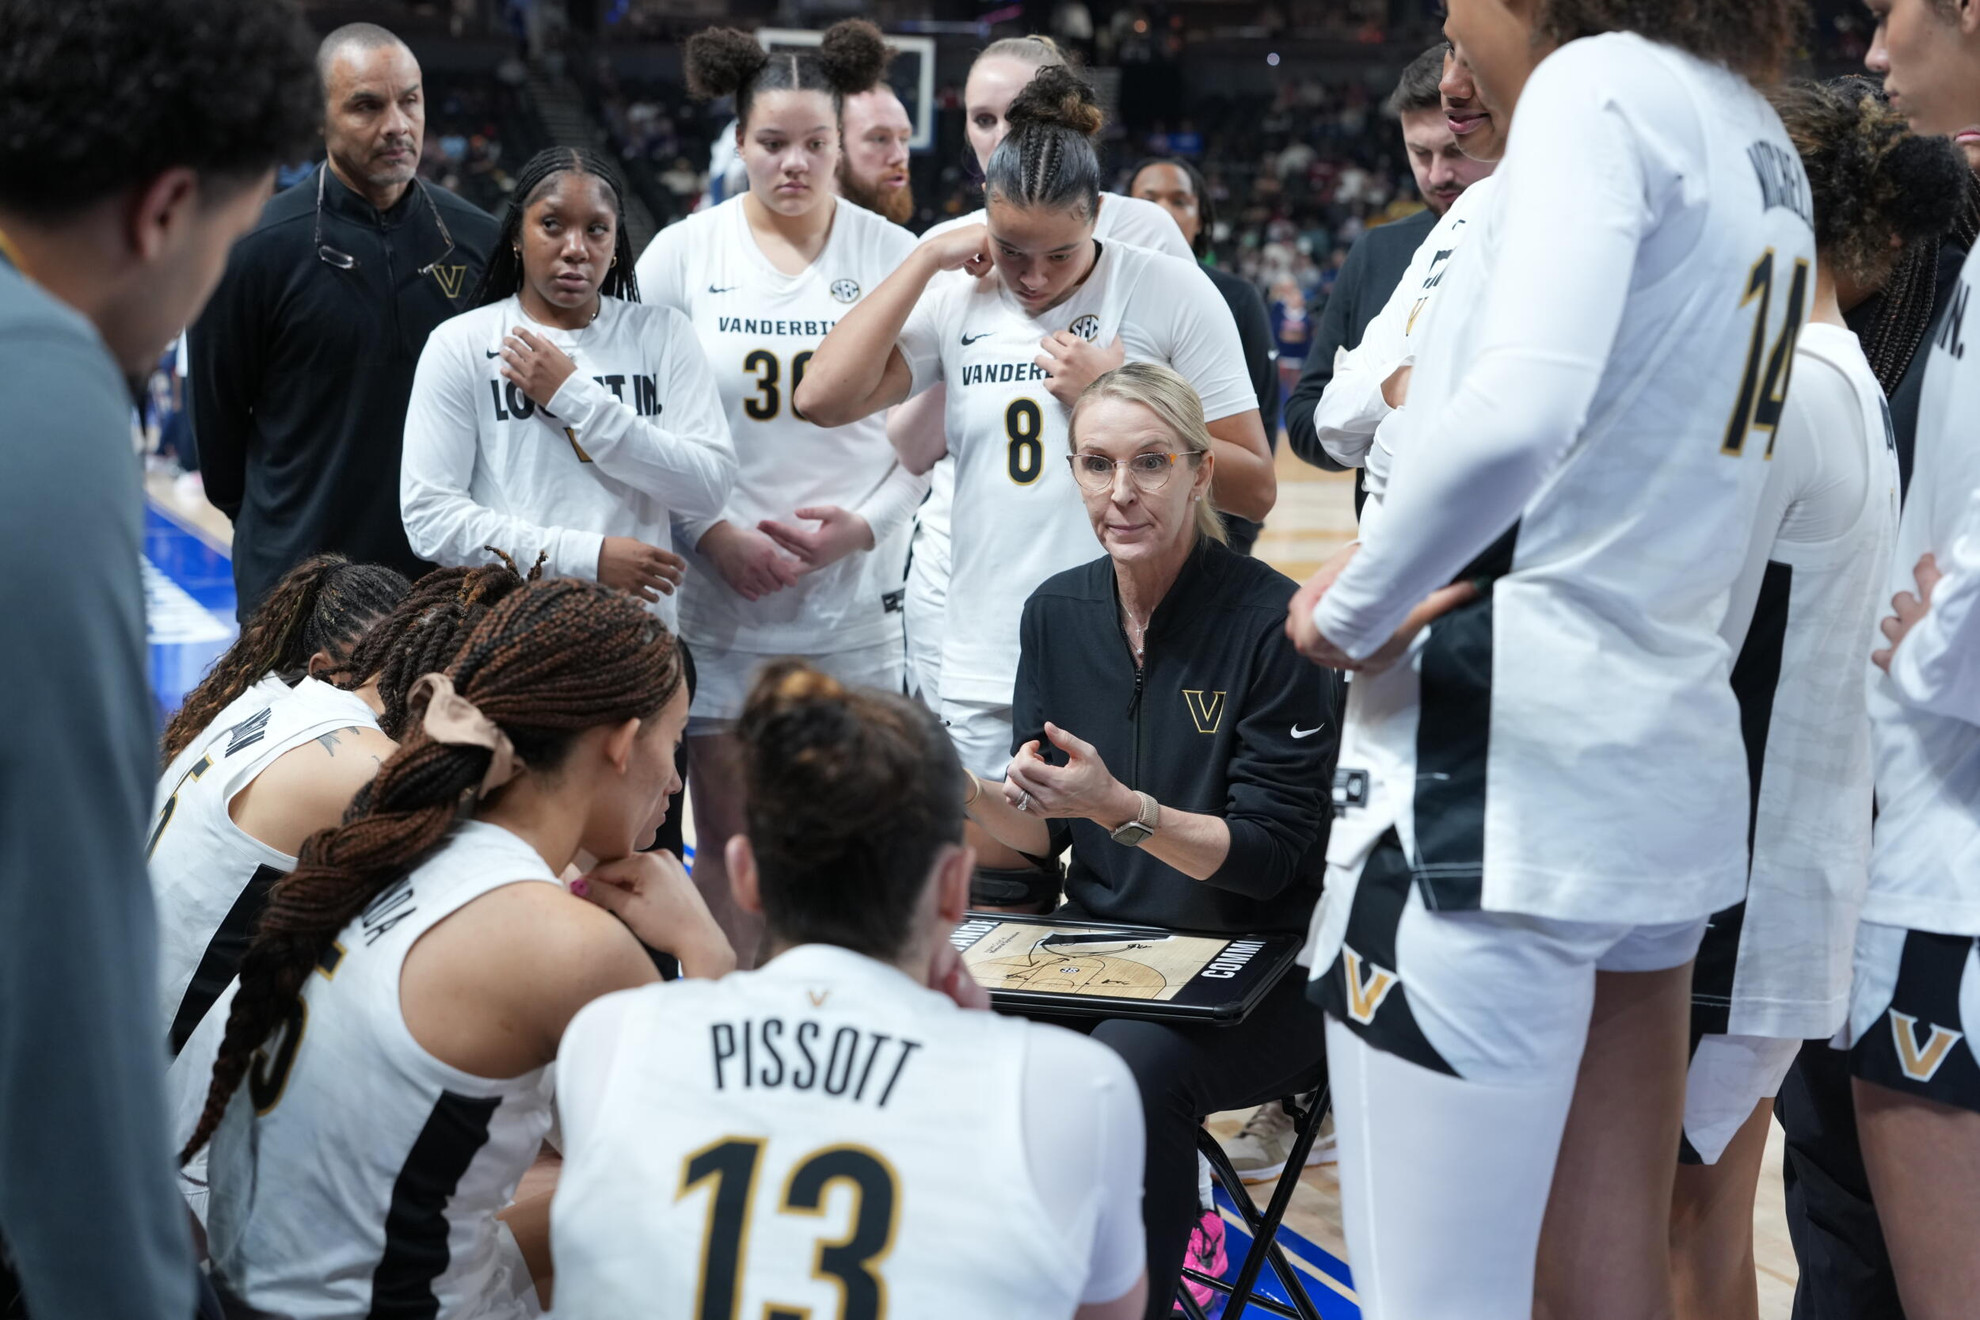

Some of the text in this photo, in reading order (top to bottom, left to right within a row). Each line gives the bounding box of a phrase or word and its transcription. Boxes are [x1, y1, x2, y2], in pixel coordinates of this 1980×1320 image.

[432, 265, 468, 298] V
[719, 317, 836, 336] VANDERBI
[1720, 246, 1810, 461] 14
[632, 373, 663, 416] IN.
[962, 362, 1054, 386] VANDER
[1004, 396, 1045, 487] 8
[1182, 689, 1227, 734] V
[1342, 942, 1400, 1026] V
[711, 1018, 924, 1110] PISSOTT
[1888, 1007, 1964, 1083] V
[673, 1132, 904, 1320] 13
